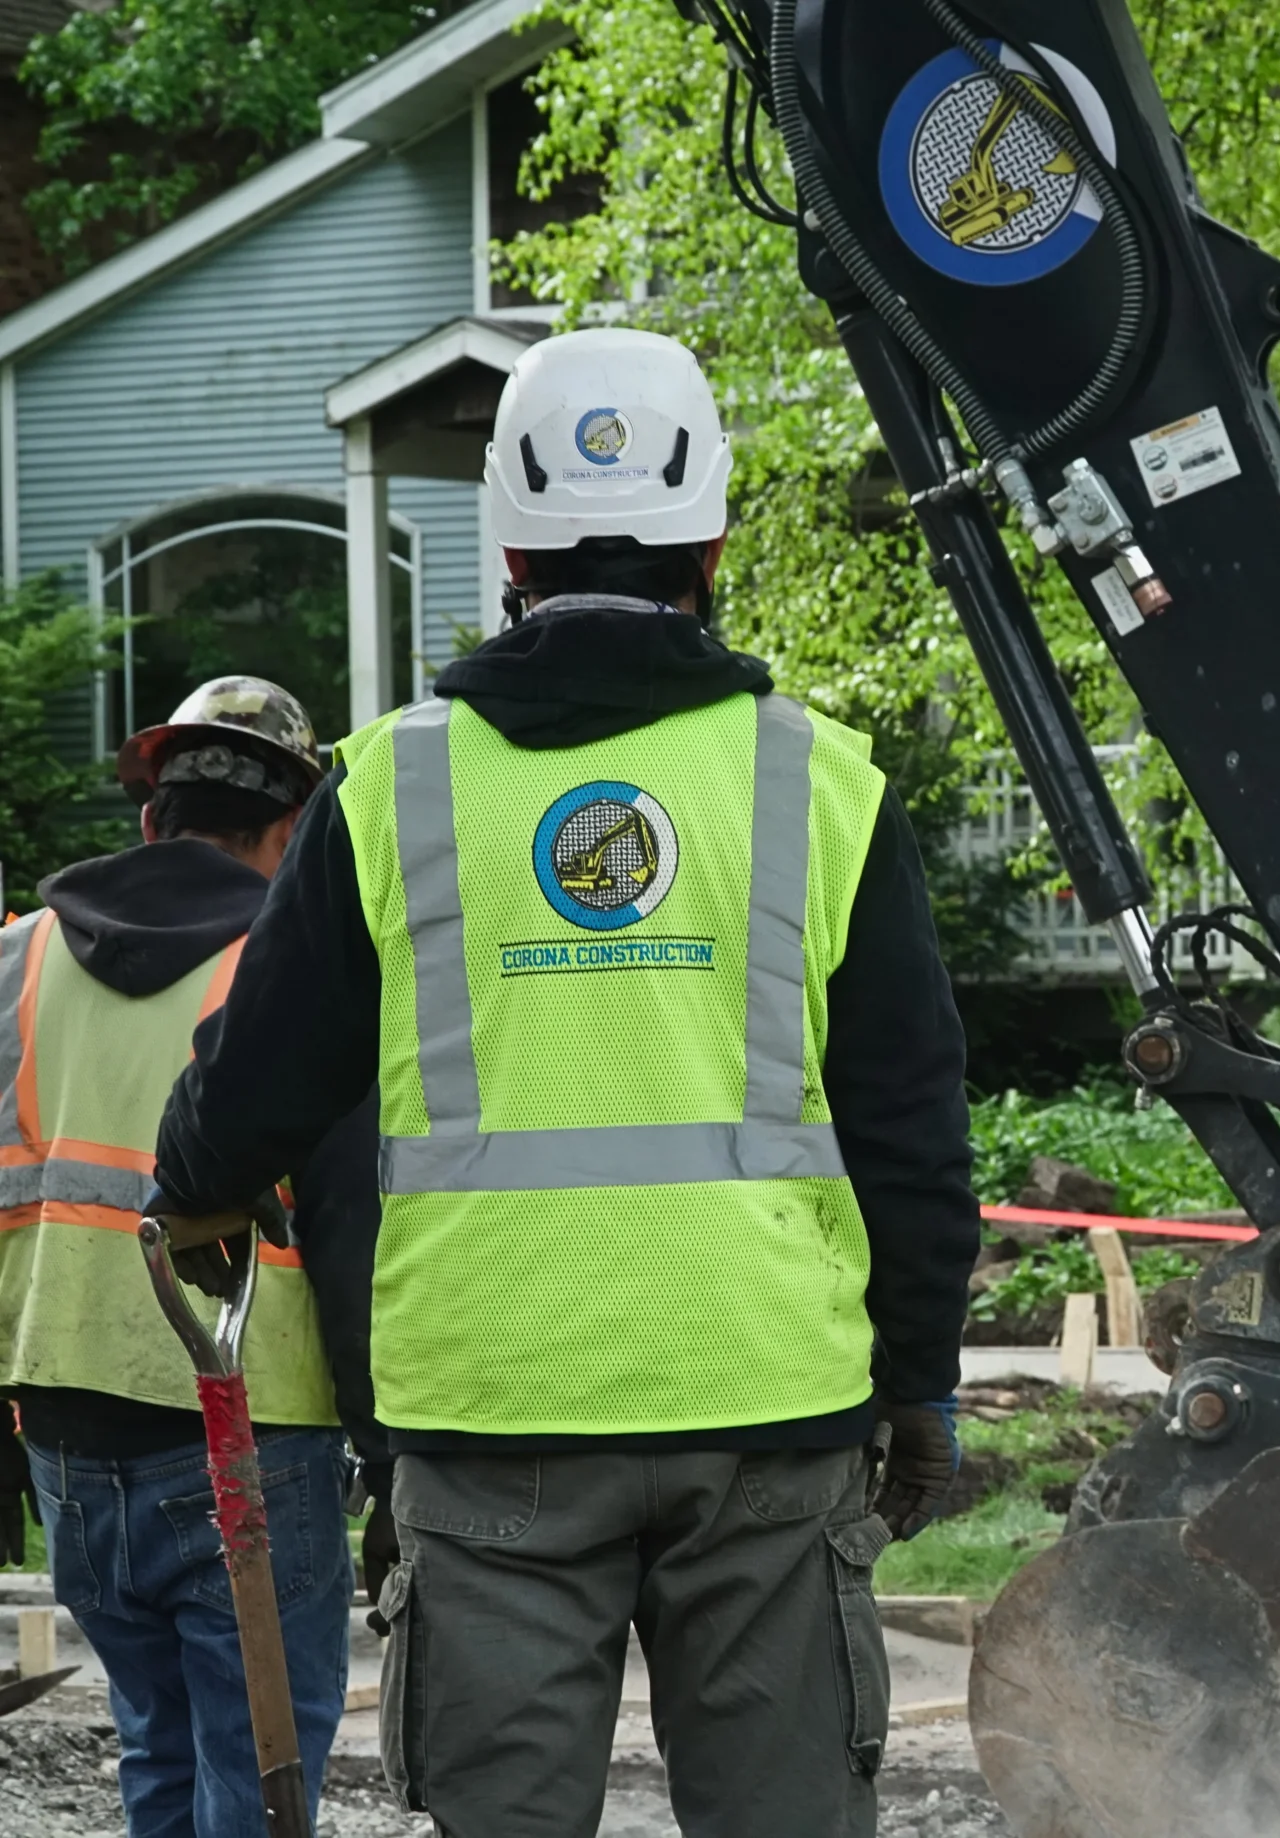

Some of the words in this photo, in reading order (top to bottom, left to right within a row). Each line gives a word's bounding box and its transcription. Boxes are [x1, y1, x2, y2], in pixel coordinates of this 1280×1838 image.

[562, 471, 591, 480] CORONA
[593, 468, 648, 478] CONSTRUCTION
[502, 947, 571, 969] CORONA
[576, 943, 713, 965] CONSTRUCTION
